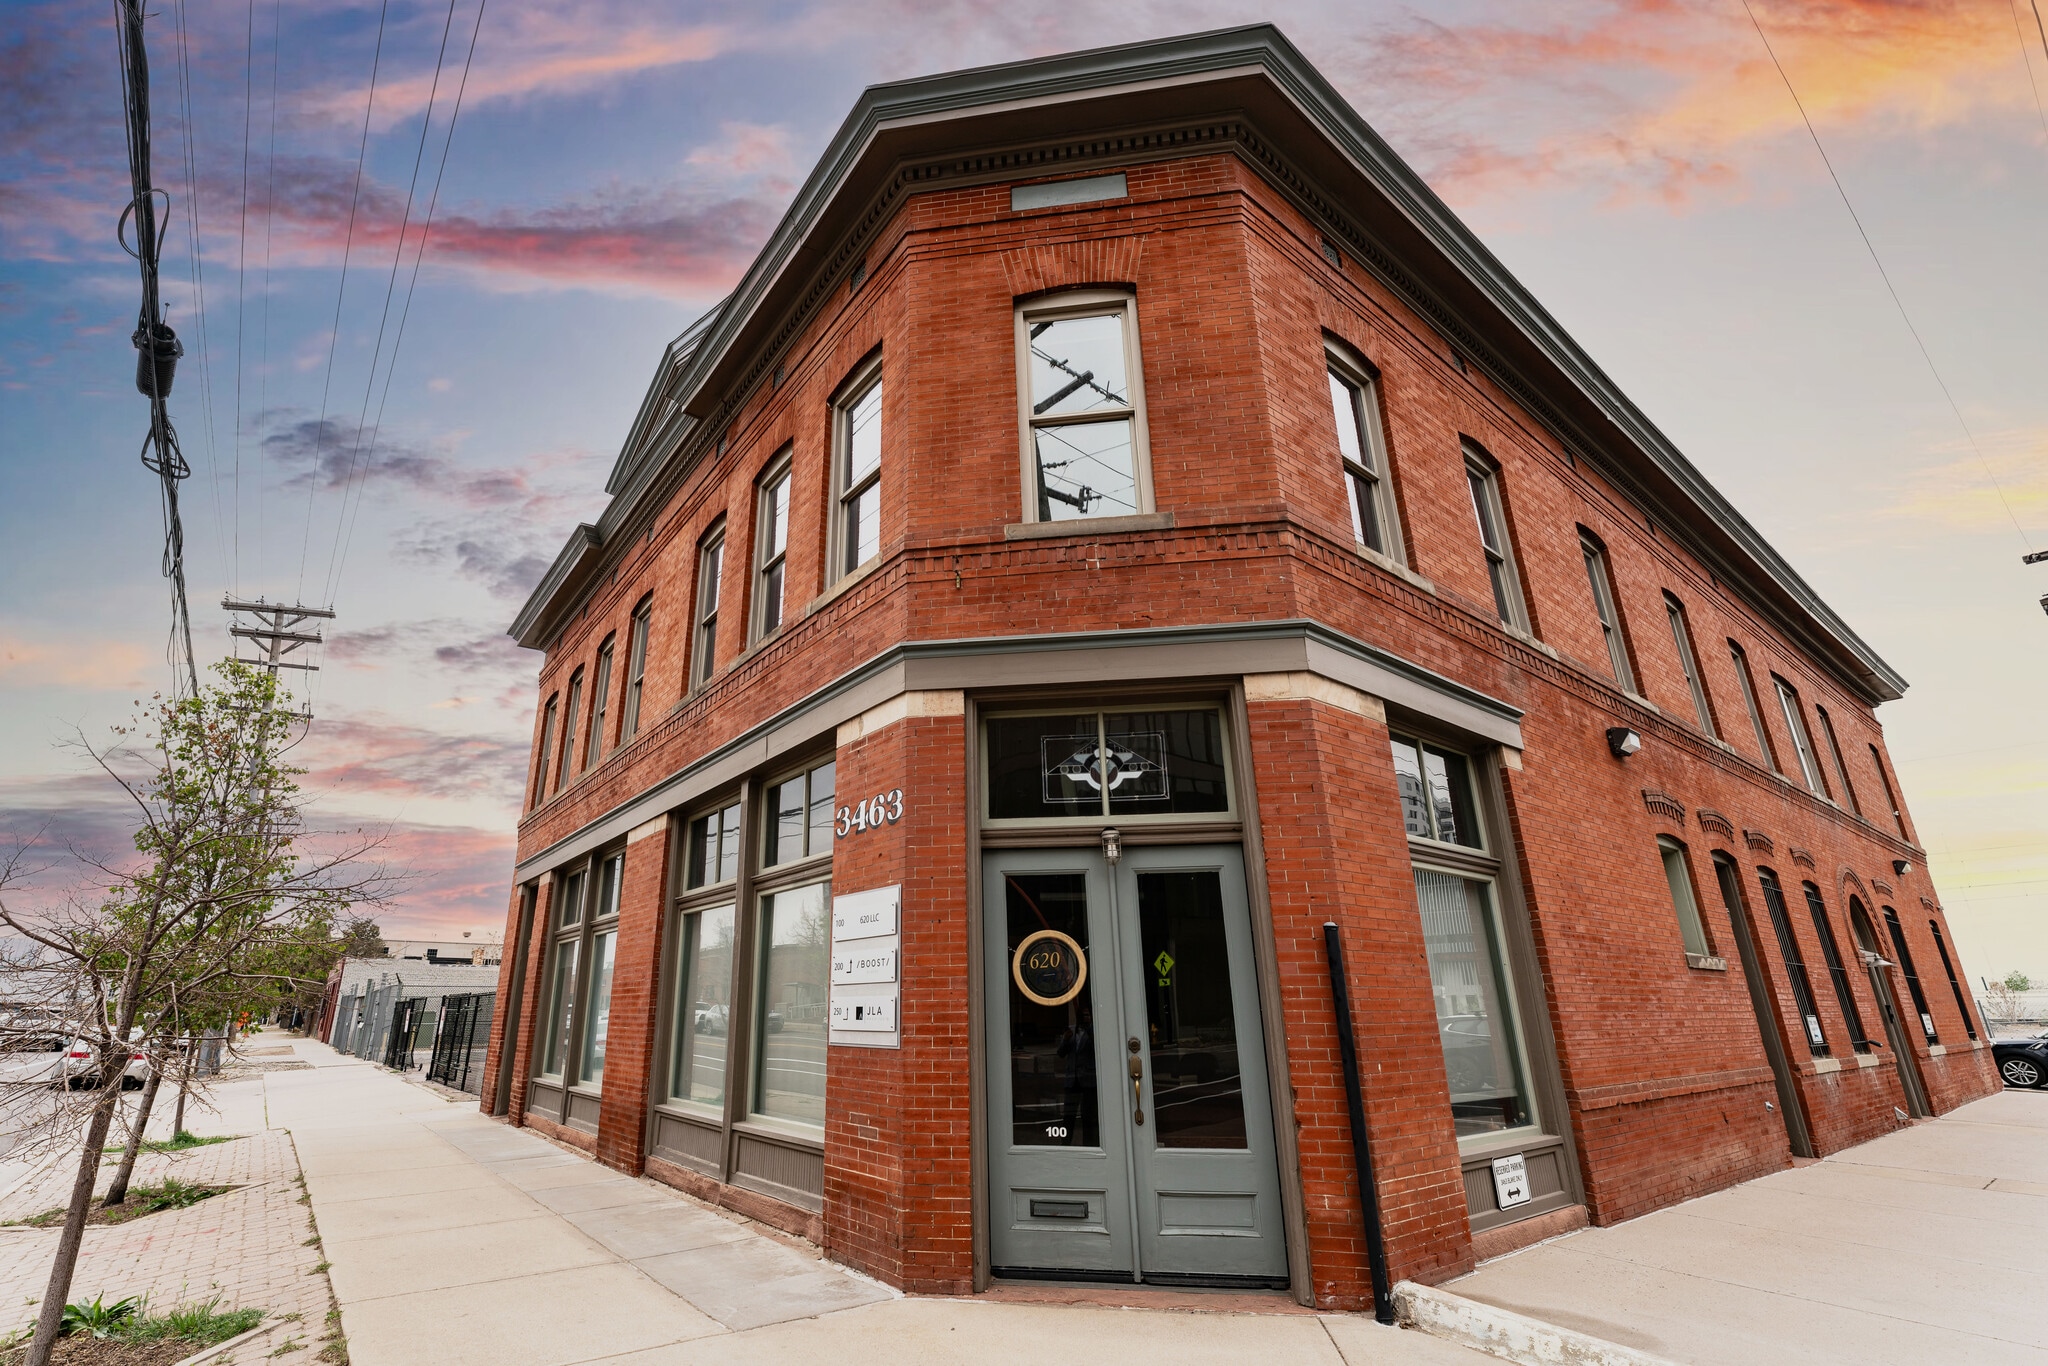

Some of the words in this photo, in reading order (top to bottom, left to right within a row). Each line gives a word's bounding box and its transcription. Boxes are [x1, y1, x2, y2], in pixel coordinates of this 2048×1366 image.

[836, 788, 904, 840] 3463
[836, 919, 845, 927] 100
[860, 915, 870, 924] 620
[870, 913, 880, 922] LLC
[1030, 952, 1060, 969] 620
[834, 962, 844, 970] 200
[834, 1008, 842, 1016] 250
[867, 1006, 882, 1016] JLA
[1046, 1126, 1068, 1138] 100
